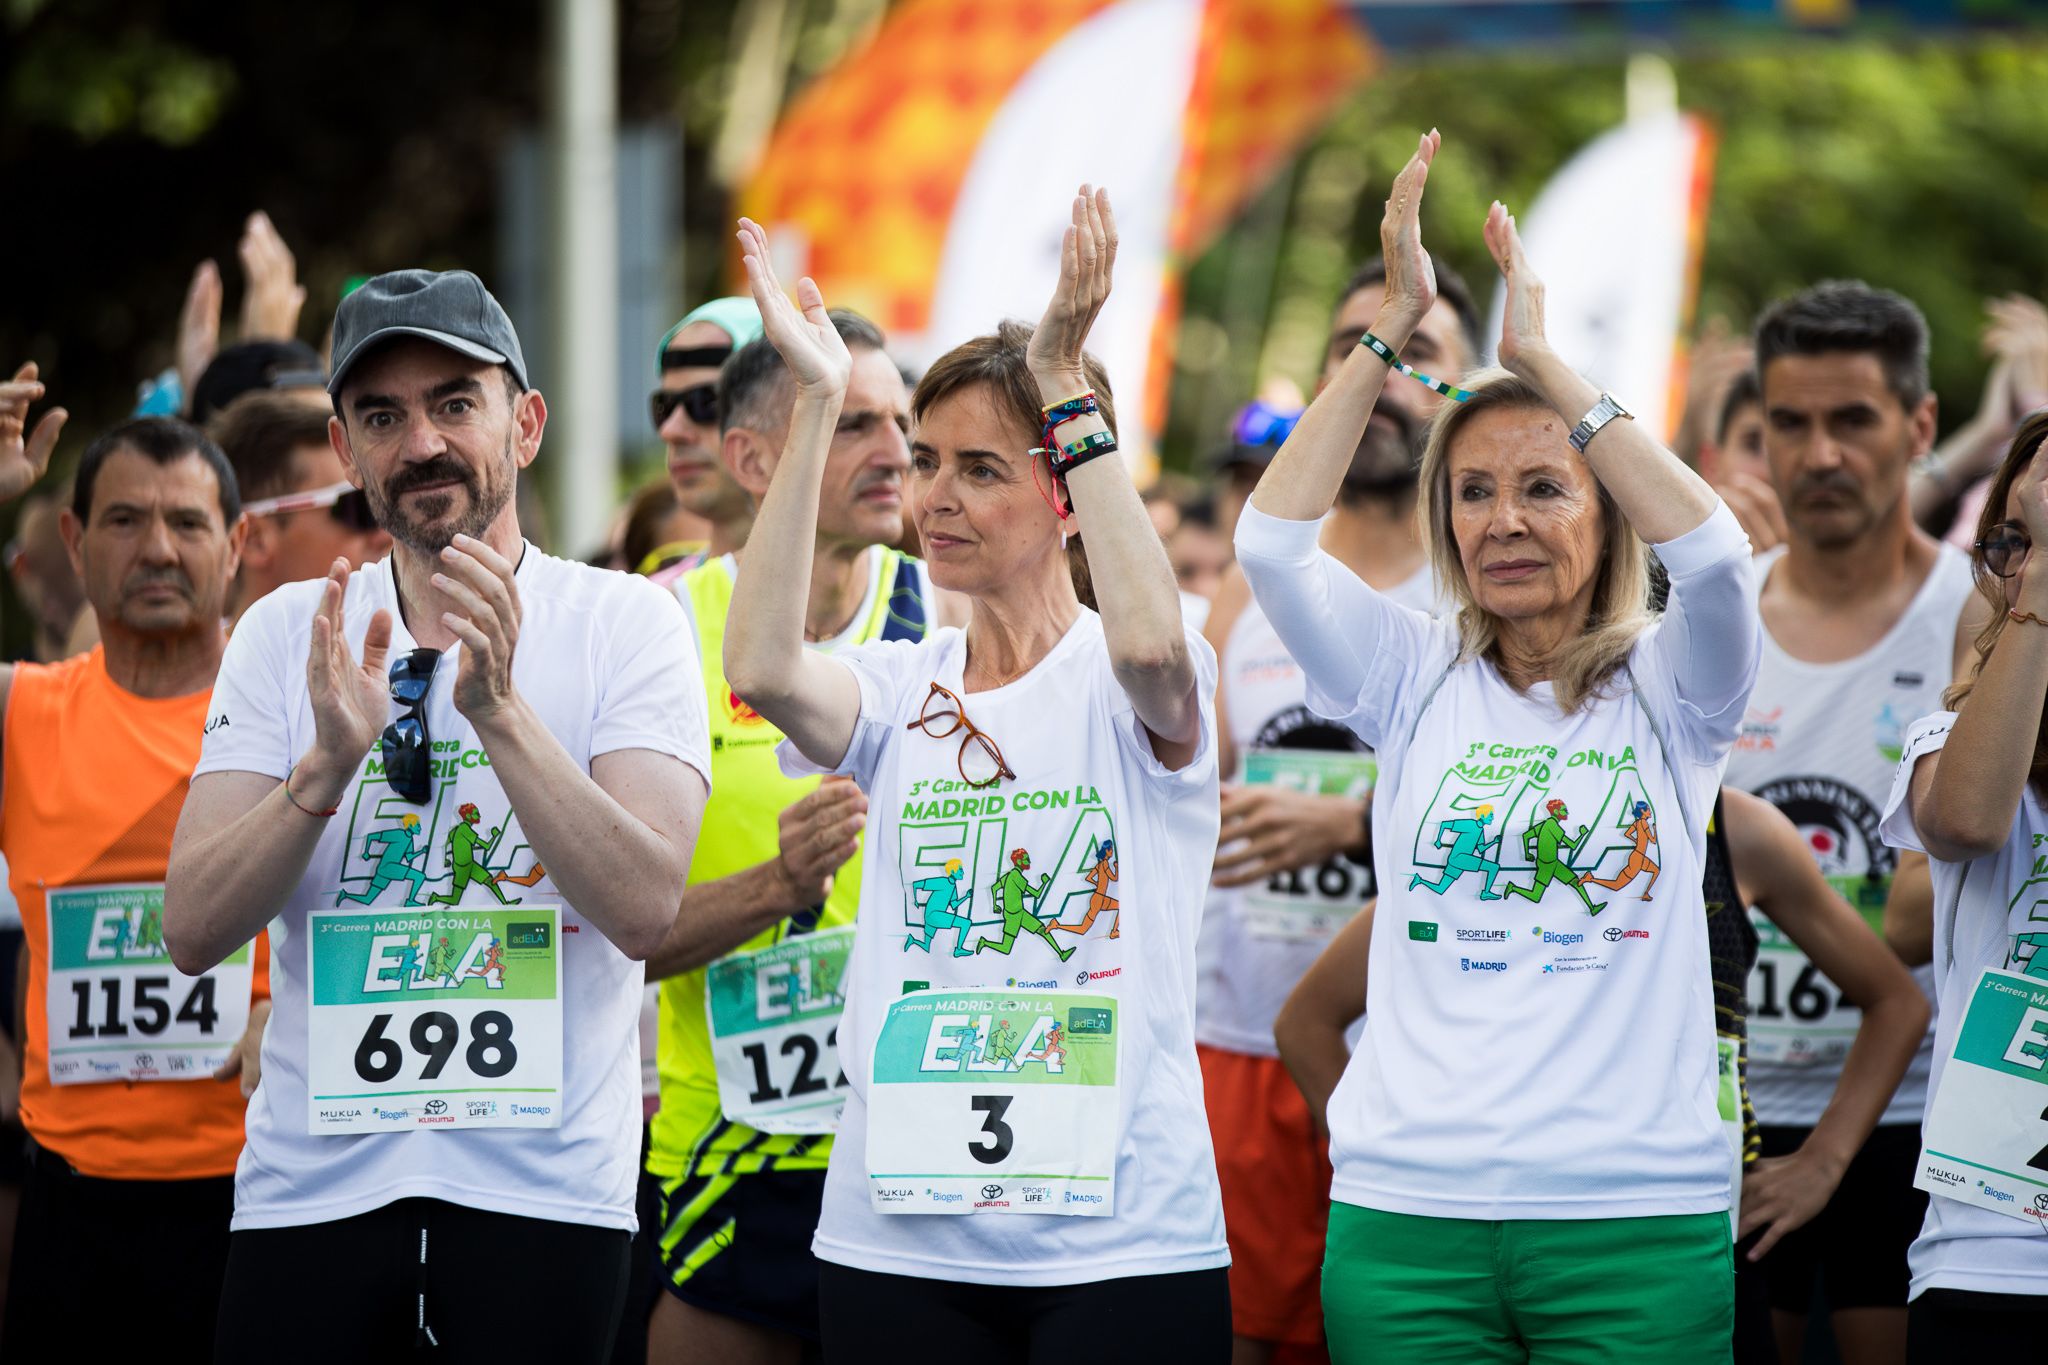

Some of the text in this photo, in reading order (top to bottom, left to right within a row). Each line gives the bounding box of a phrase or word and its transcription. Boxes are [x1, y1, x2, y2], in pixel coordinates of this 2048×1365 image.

[1566, 749, 1604, 769] ON
[1455, 760, 1551, 783] MADRID
[902, 785, 1102, 820] MADRID CON LA
[334, 923, 370, 933] Carrera
[374, 920, 432, 932] MADRID
[437, 918, 471, 929] CON
[473, 918, 492, 929] LA
[86, 908, 170, 960] EL
[1543, 931, 1584, 946] Biogen
[362, 932, 504, 994] ELA
[1471, 961, 1508, 972] MADRID
[756, 957, 848, 1021] EL
[1994, 982, 2028, 999] Carrera
[69, 977, 219, 1038] 1154
[935, 1001, 994, 1012] MADRID
[998, 1001, 1031, 1012] CON
[1035, 1001, 1054, 1012] LA
[1074, 1018, 1106, 1029] adELA
[354, 1010, 518, 1083] 698
[919, 1014, 1064, 1074] ELA
[466, 1101, 490, 1109] SPORT
[469, 1108, 489, 1117] LIFE
[519, 1106, 551, 1116] MADRID
[320, 1110, 362, 1118] MUKUA
[380, 1110, 409, 1121] Biogen
[968, 1095, 1014, 1165] 3
[1927, 1166, 1966, 1184] MUKUA
[878, 1189, 914, 1197] MUKUA
[933, 1192, 963, 1203] Biogen
[1025, 1194, 1043, 1202] LIFE
[1072, 1194, 1103, 1203] MADRID
[1984, 1185, 2015, 1202] Biogen
